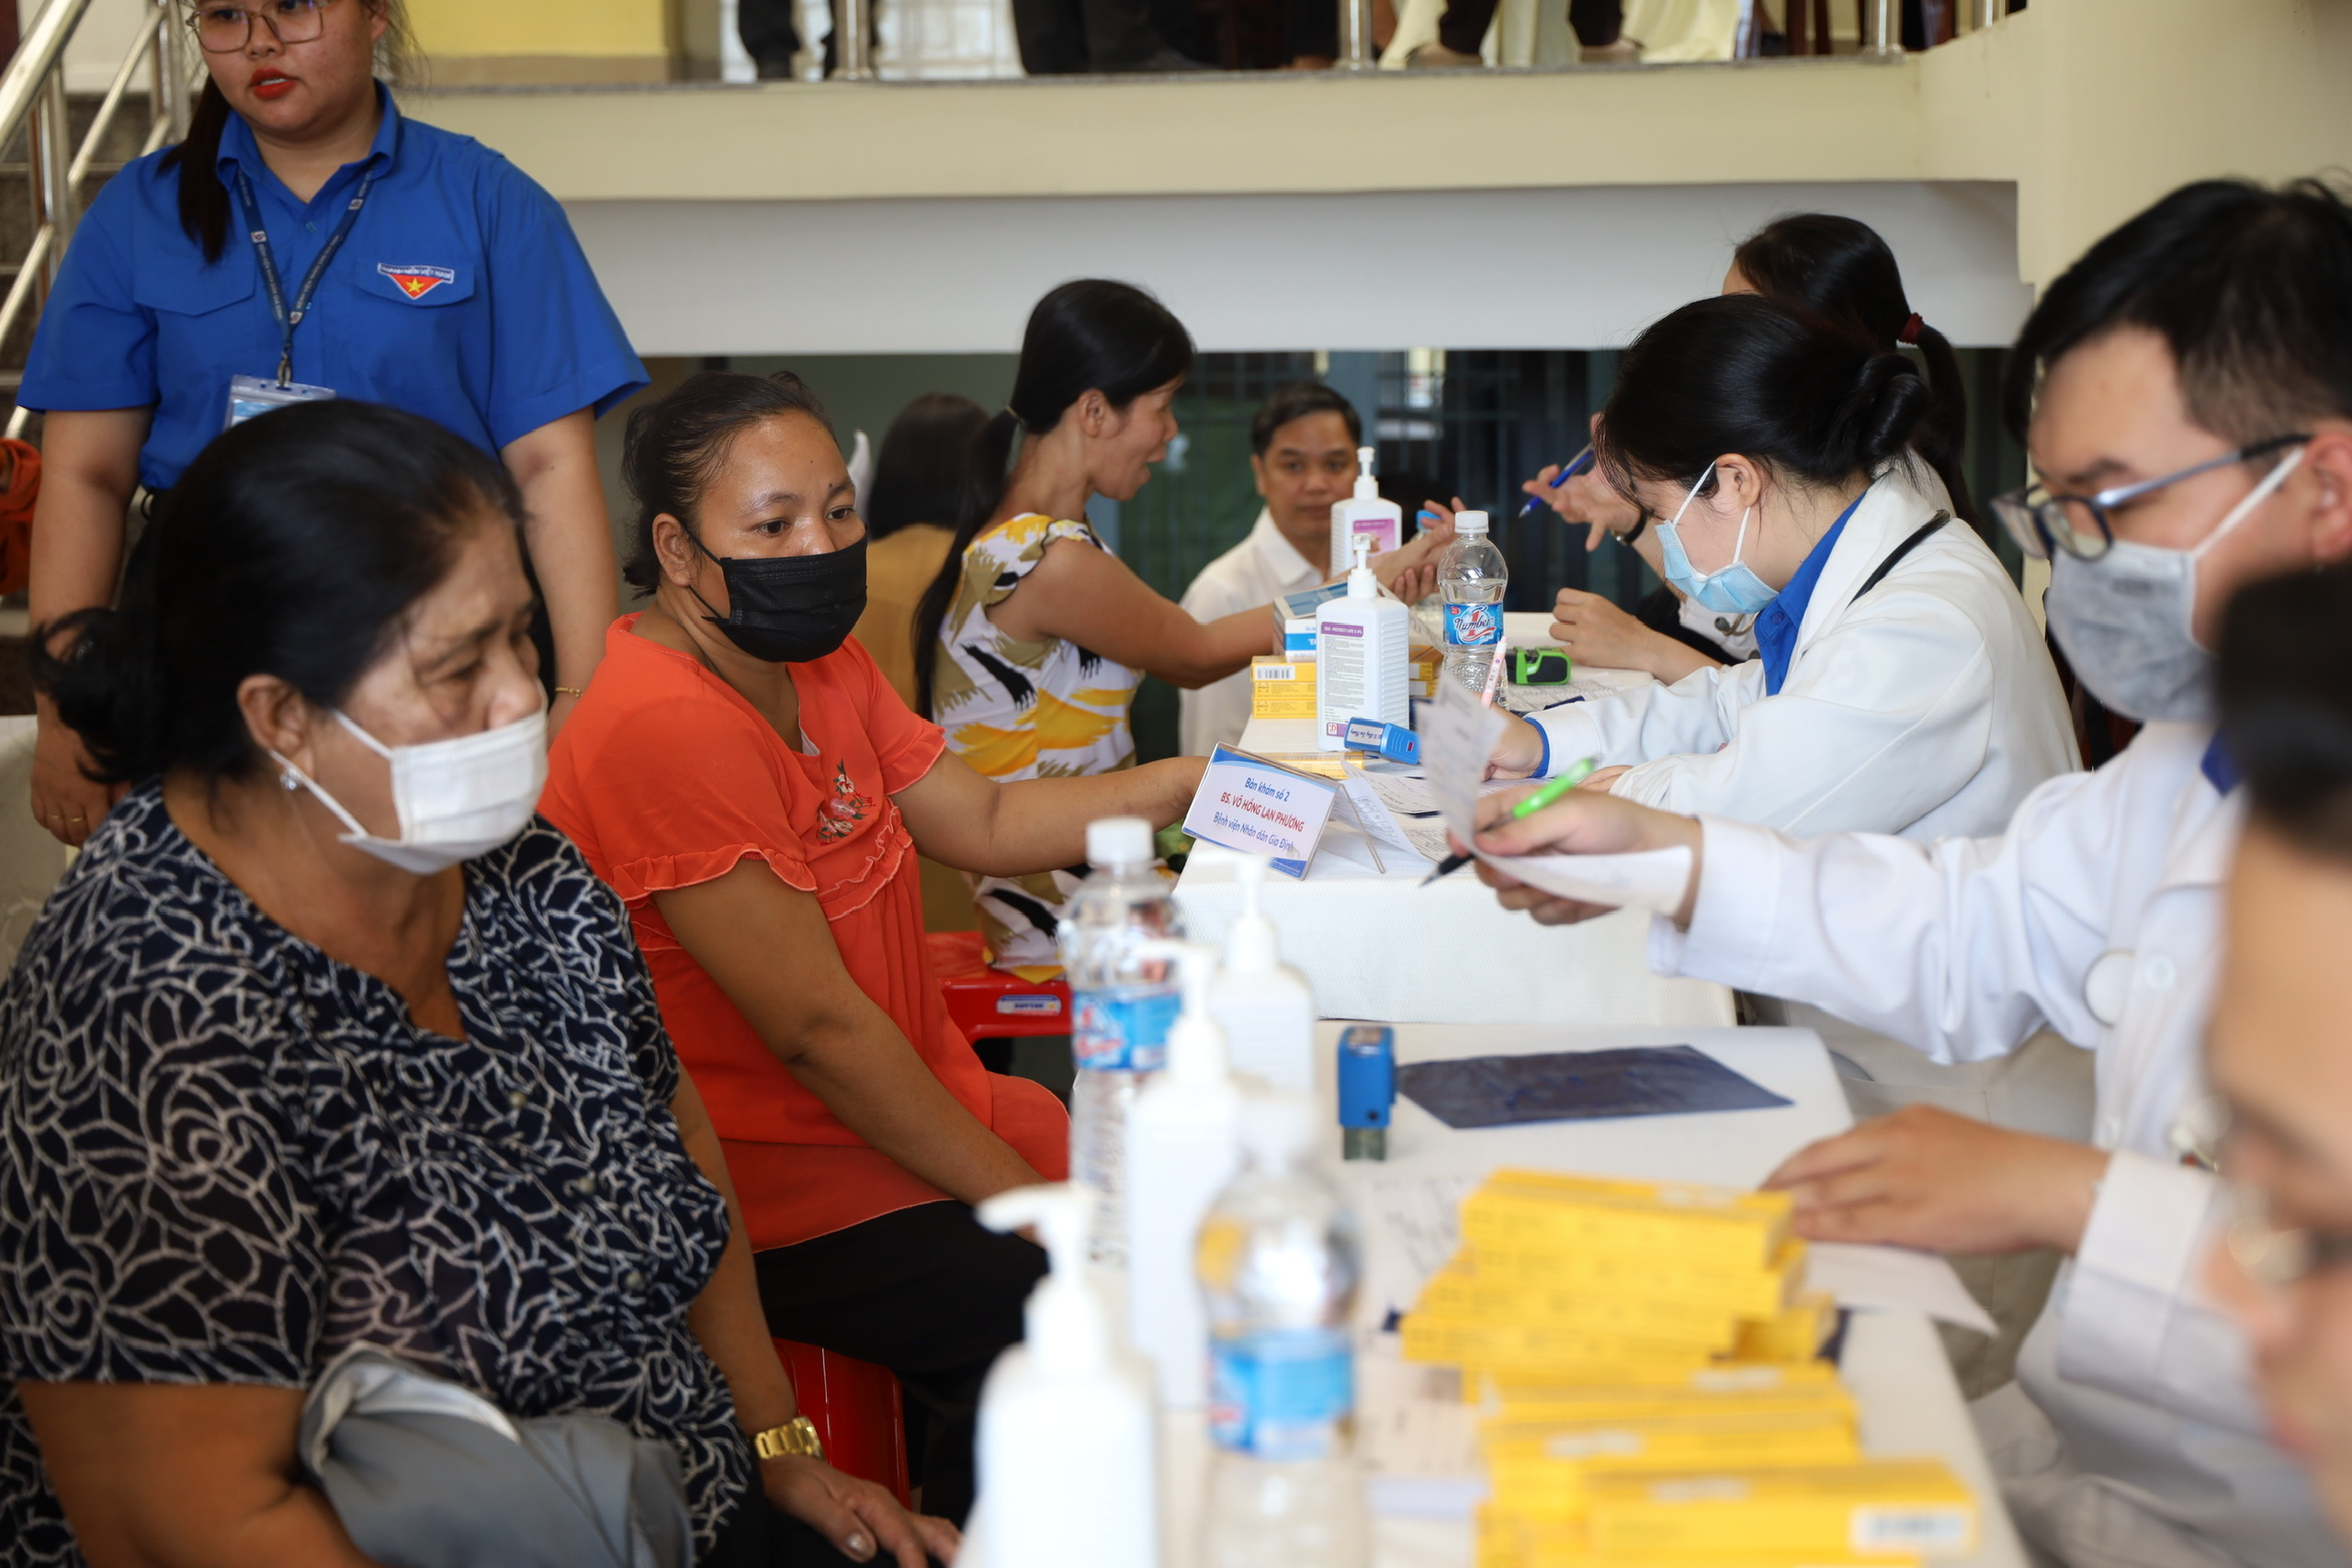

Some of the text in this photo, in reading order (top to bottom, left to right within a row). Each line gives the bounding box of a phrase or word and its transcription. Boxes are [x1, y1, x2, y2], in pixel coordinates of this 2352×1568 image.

[1454, 615, 1494, 632] Number
[1245, 777, 1290, 802] Bàn khám số 2
[1220, 792, 1305, 832] BS. VÕ HỒNG LAN PHƯƠNG
[1213, 811, 1228, 827] Bệnh
[1228, 816, 1240, 832] viện
[1240, 821, 1256, 837] Nhân
[1256, 827, 1268, 842] dân
[1268, 833, 1279, 847] Gia
